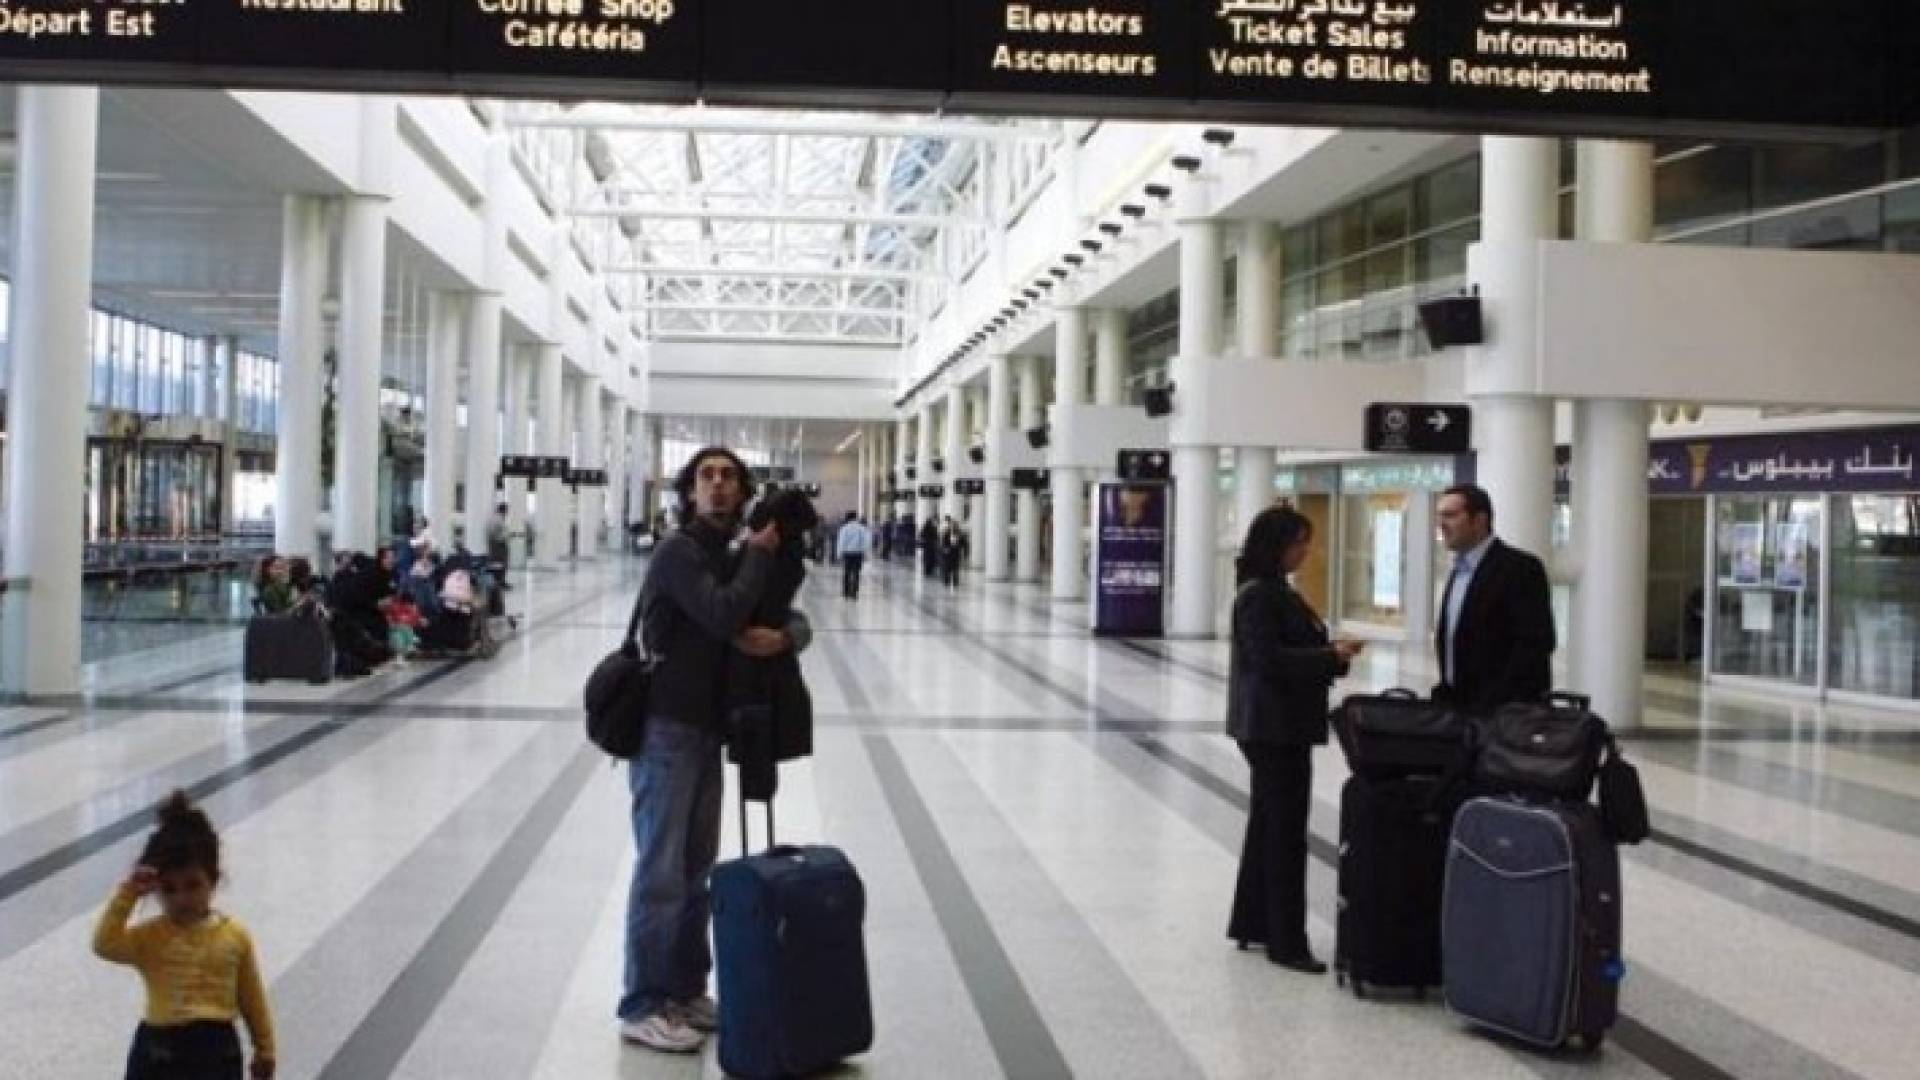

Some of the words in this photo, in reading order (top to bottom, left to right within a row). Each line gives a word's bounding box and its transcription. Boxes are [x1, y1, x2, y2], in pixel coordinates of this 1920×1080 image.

[107, 9, 155, 36] Est
[504, 18, 646, 51] Cafétéria
[1006, 4, 1143, 36] Elevators
[1229, 16, 1317, 45] Ticket
[1327, 21, 1405, 49] Sales
[992, 44, 1157, 76] Ascenseurs
[1476, 28, 1628, 60] Information
[1210, 49, 1293, 77] Vente
[1303, 53, 1338, 79] de
[1450, 58, 1651, 93] Renseignement
[1844, 445, 1913, 479] بنك
